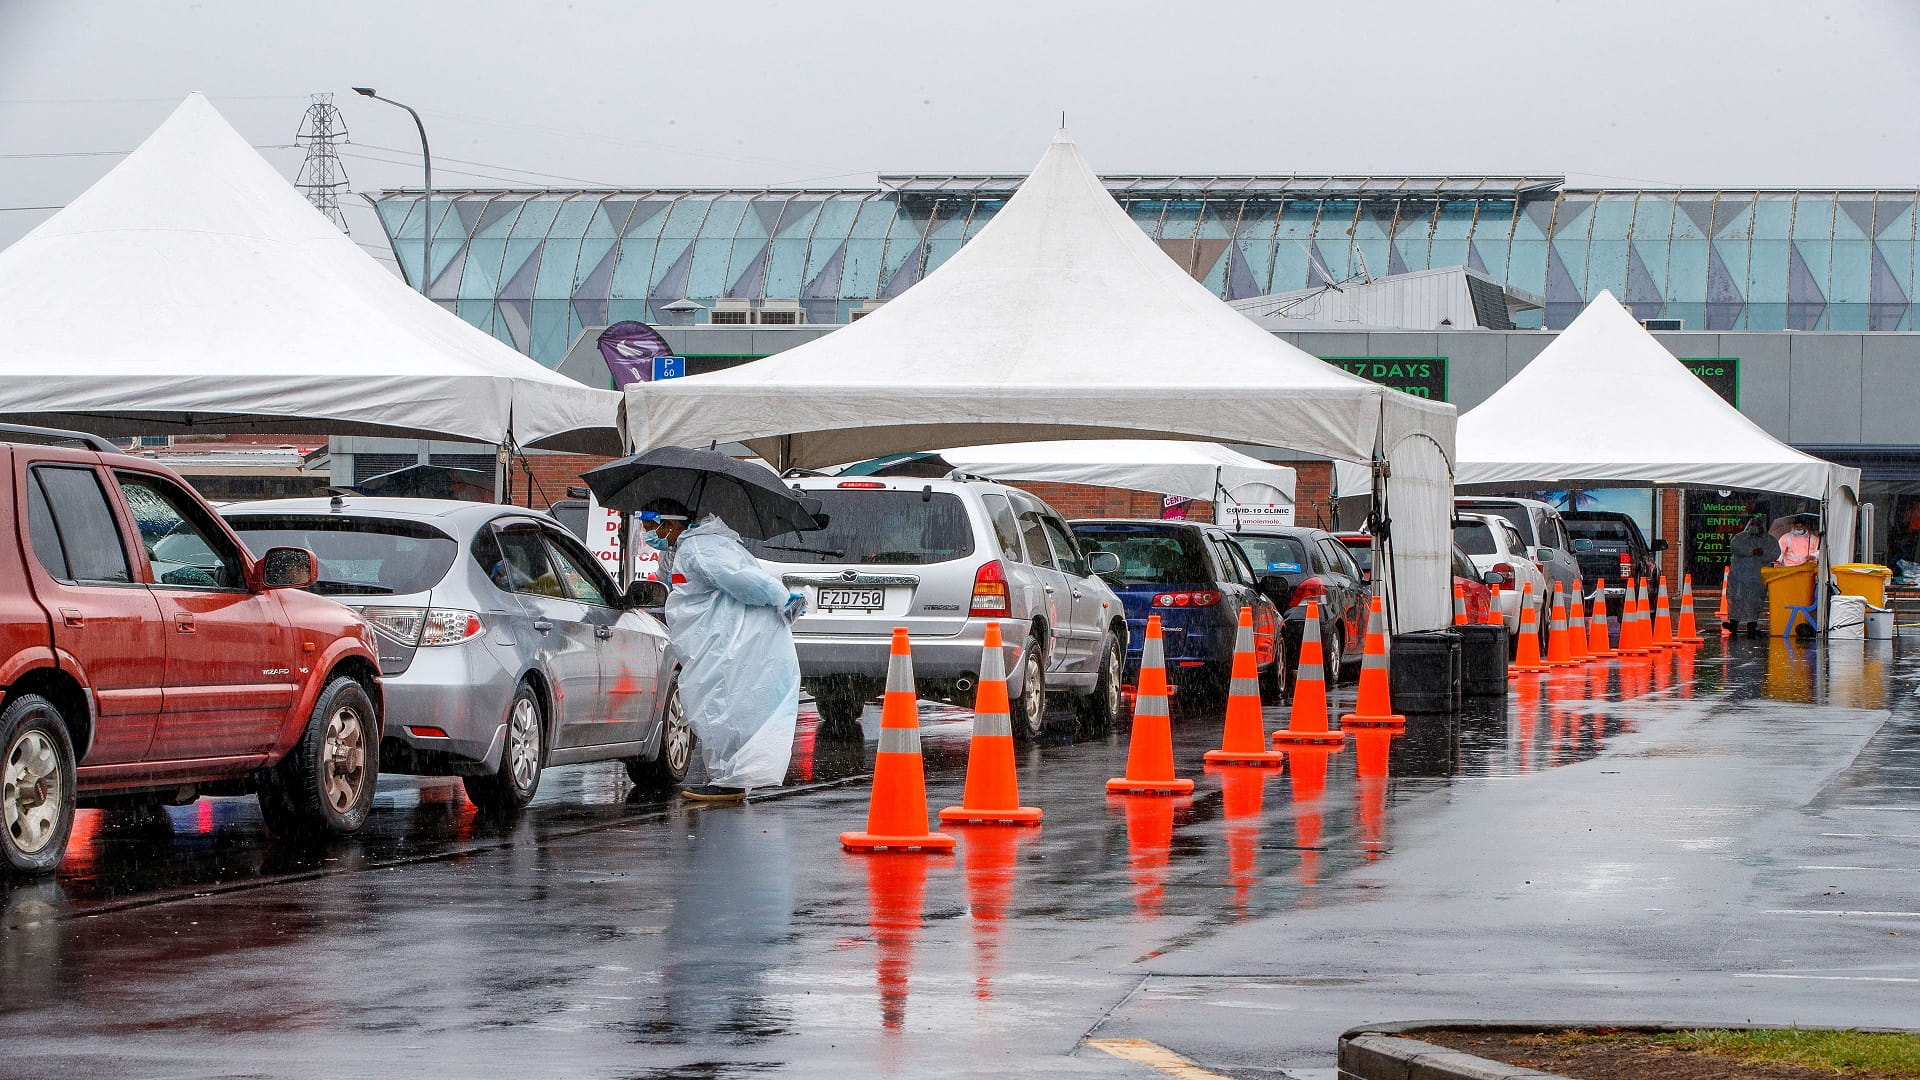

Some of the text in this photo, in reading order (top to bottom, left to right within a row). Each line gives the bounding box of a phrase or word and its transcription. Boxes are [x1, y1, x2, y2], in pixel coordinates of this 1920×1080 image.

[664, 358, 674, 368] P
[663, 369, 675, 377] 60
[1355, 364, 1367, 377] 7
[1372, 364, 1430, 378] DAYS
[1703, 503, 1747, 511] Welcome
[1707, 517, 1741, 526] ENTRY
[1696, 541, 1723, 550] 7am
[1697, 555, 1713, 563] Ph.
[820, 591, 881, 605] FZD750
